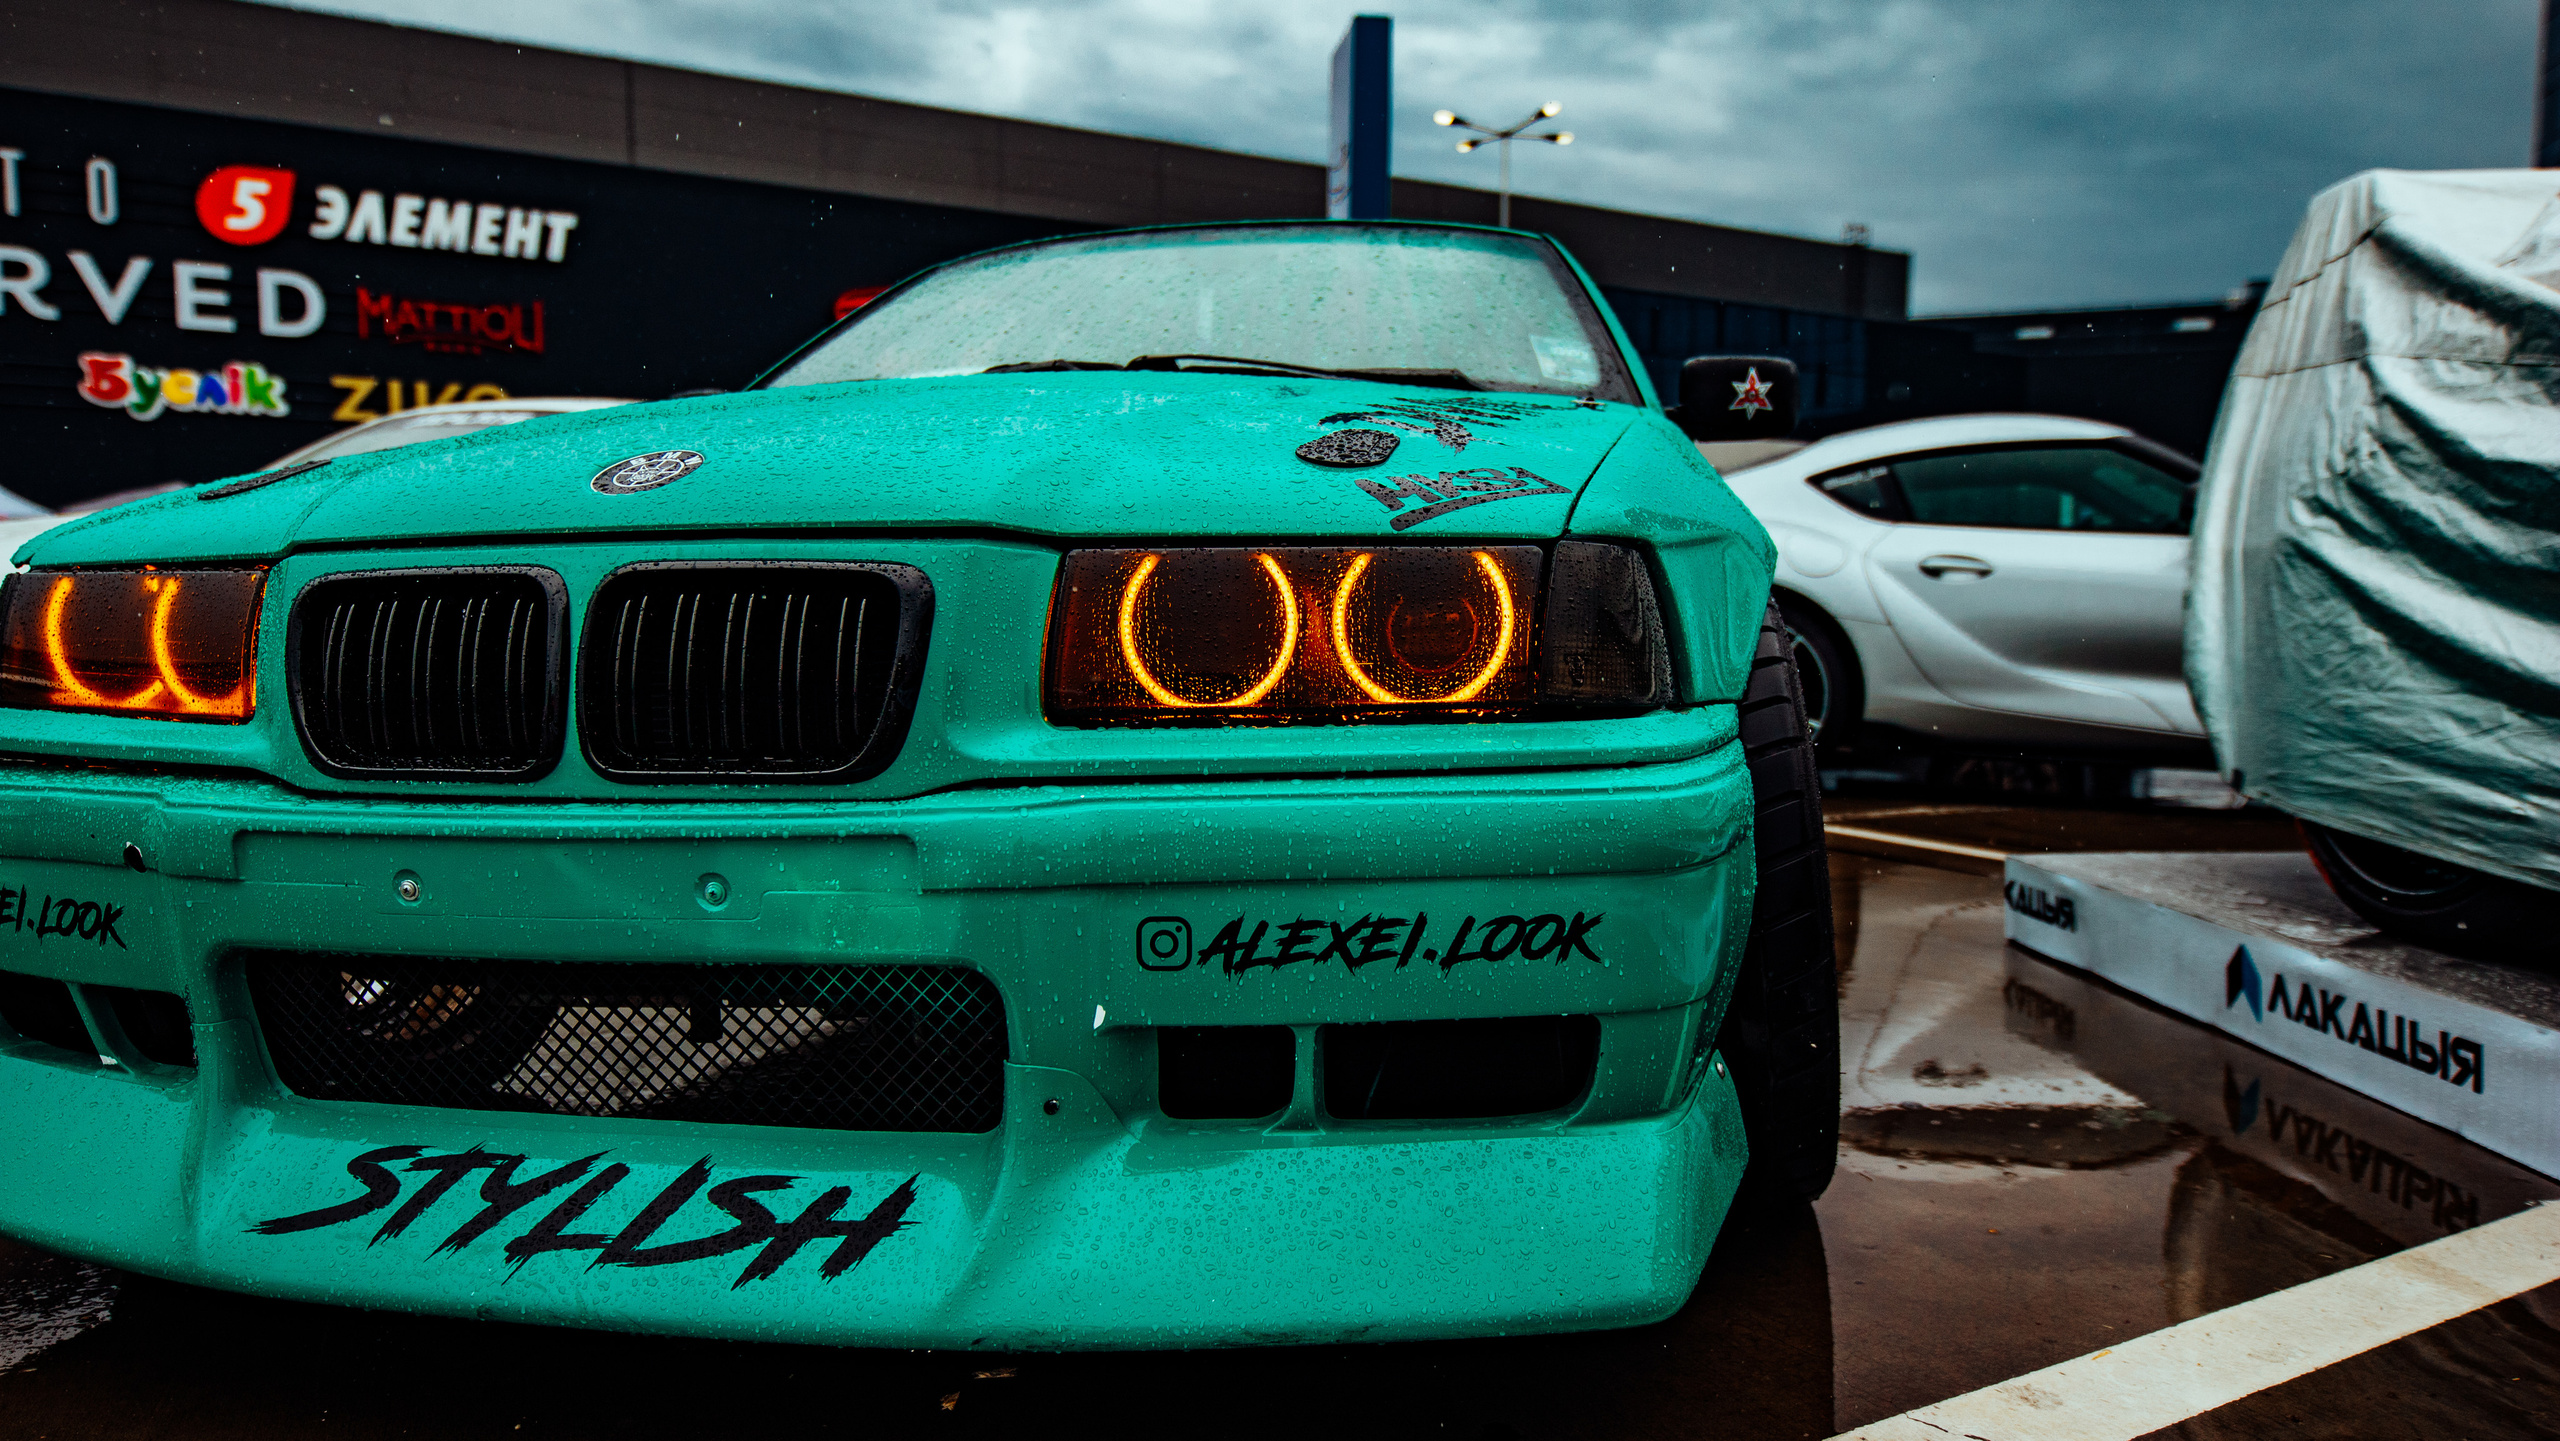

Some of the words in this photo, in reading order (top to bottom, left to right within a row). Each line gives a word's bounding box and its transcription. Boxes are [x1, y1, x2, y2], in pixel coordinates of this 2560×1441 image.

[223, 176, 272, 231] 5
[308, 185, 578, 262] ЭЛЕМЕНТ
[1197, 911, 1606, 984] ALEXEI.LOOK
[2268, 973, 2485, 1094] ЛАКАЦЫЯ
[241, 1140, 922, 1291] STYLISH
